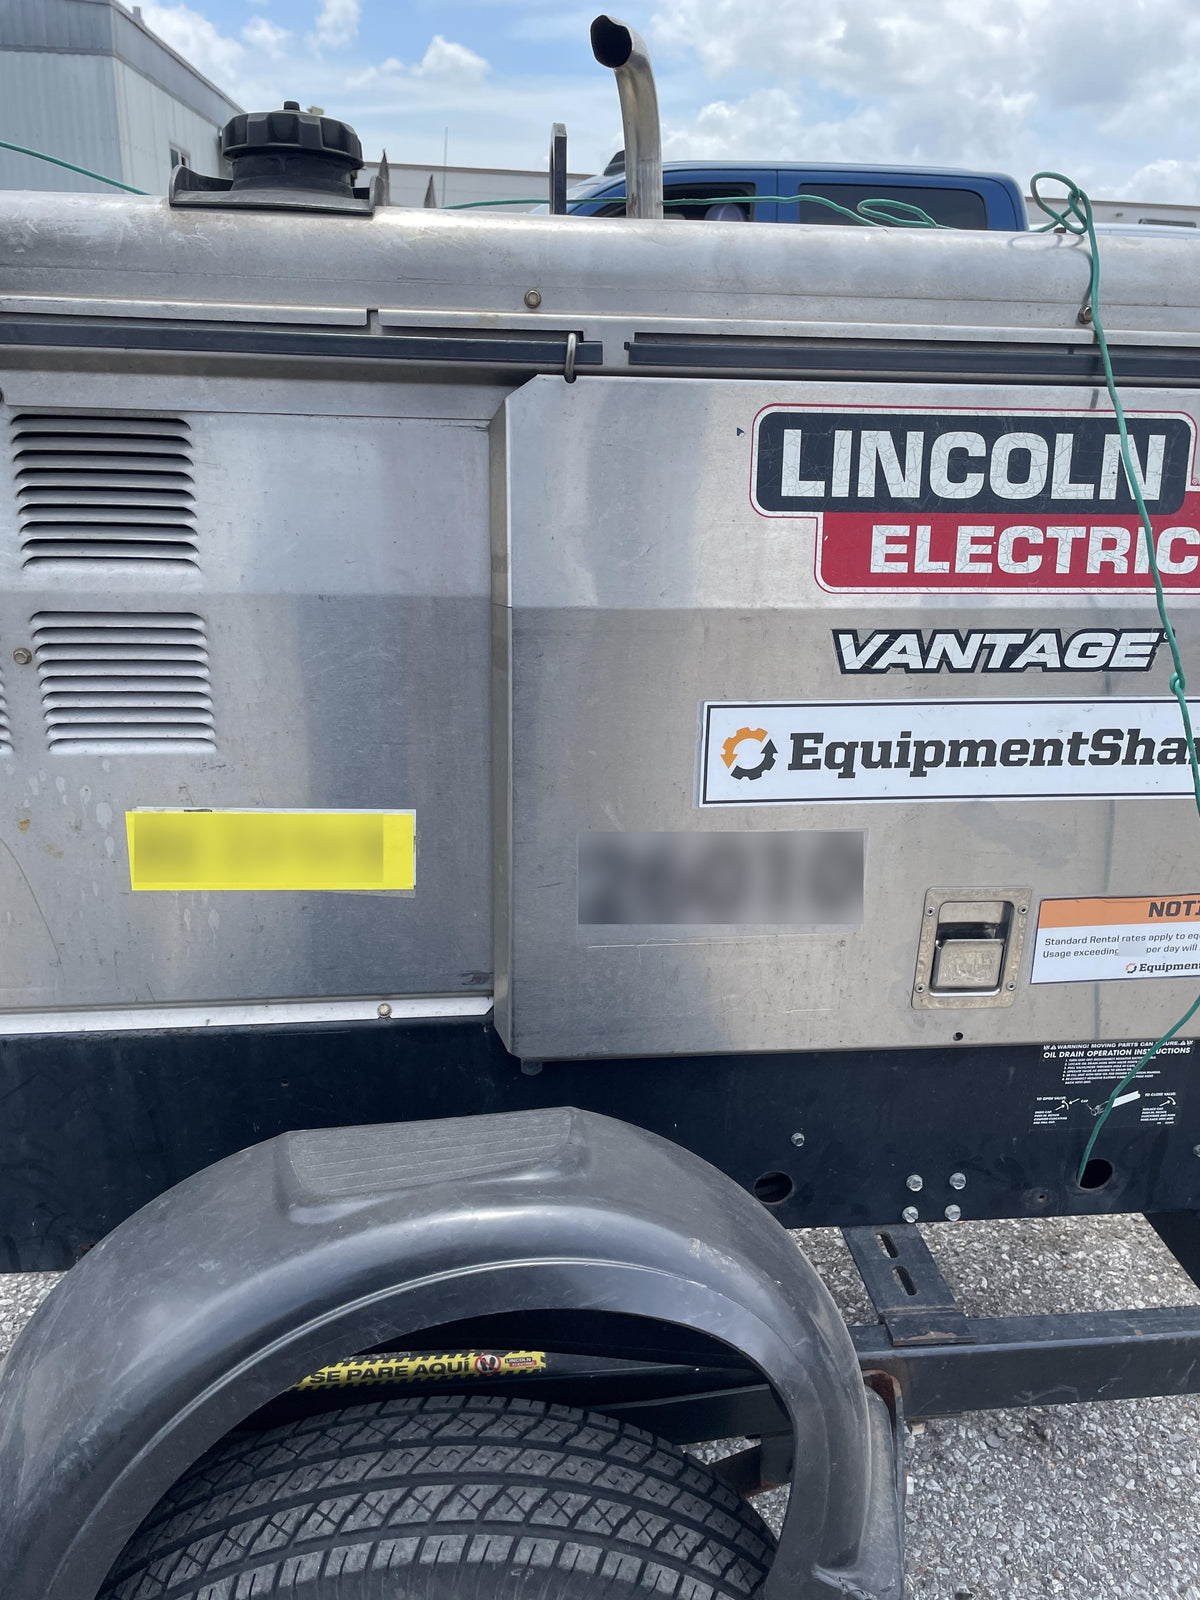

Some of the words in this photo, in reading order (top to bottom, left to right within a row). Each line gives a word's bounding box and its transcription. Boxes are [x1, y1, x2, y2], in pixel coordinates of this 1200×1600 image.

[781, 429, 1166, 500] LINCOLN
[870, 525, 1200, 574] ELECTRIC
[834, 631, 1162, 671] VANTAGE
[1045, 936, 1087, 945] Standard
[1090, 935, 1119, 943] Rental
[1148, 933, 1173, 942] apply
[1187, 933, 1200, 941] eq
[1043, 950, 1071, 958] Usage
[1146, 946, 1161, 954] per
[1163, 945, 1180, 953] day
[1182, 943, 1197, 951] will
[1059, 1050, 1084, 1058] DRAIN
[1087, 1048, 1132, 1057] OPERATION
[1134, 1047, 1190, 1055] INSUCTIONS
[310, 1370, 340, 1383] SE
[346, 1366, 408, 1381] PARE
